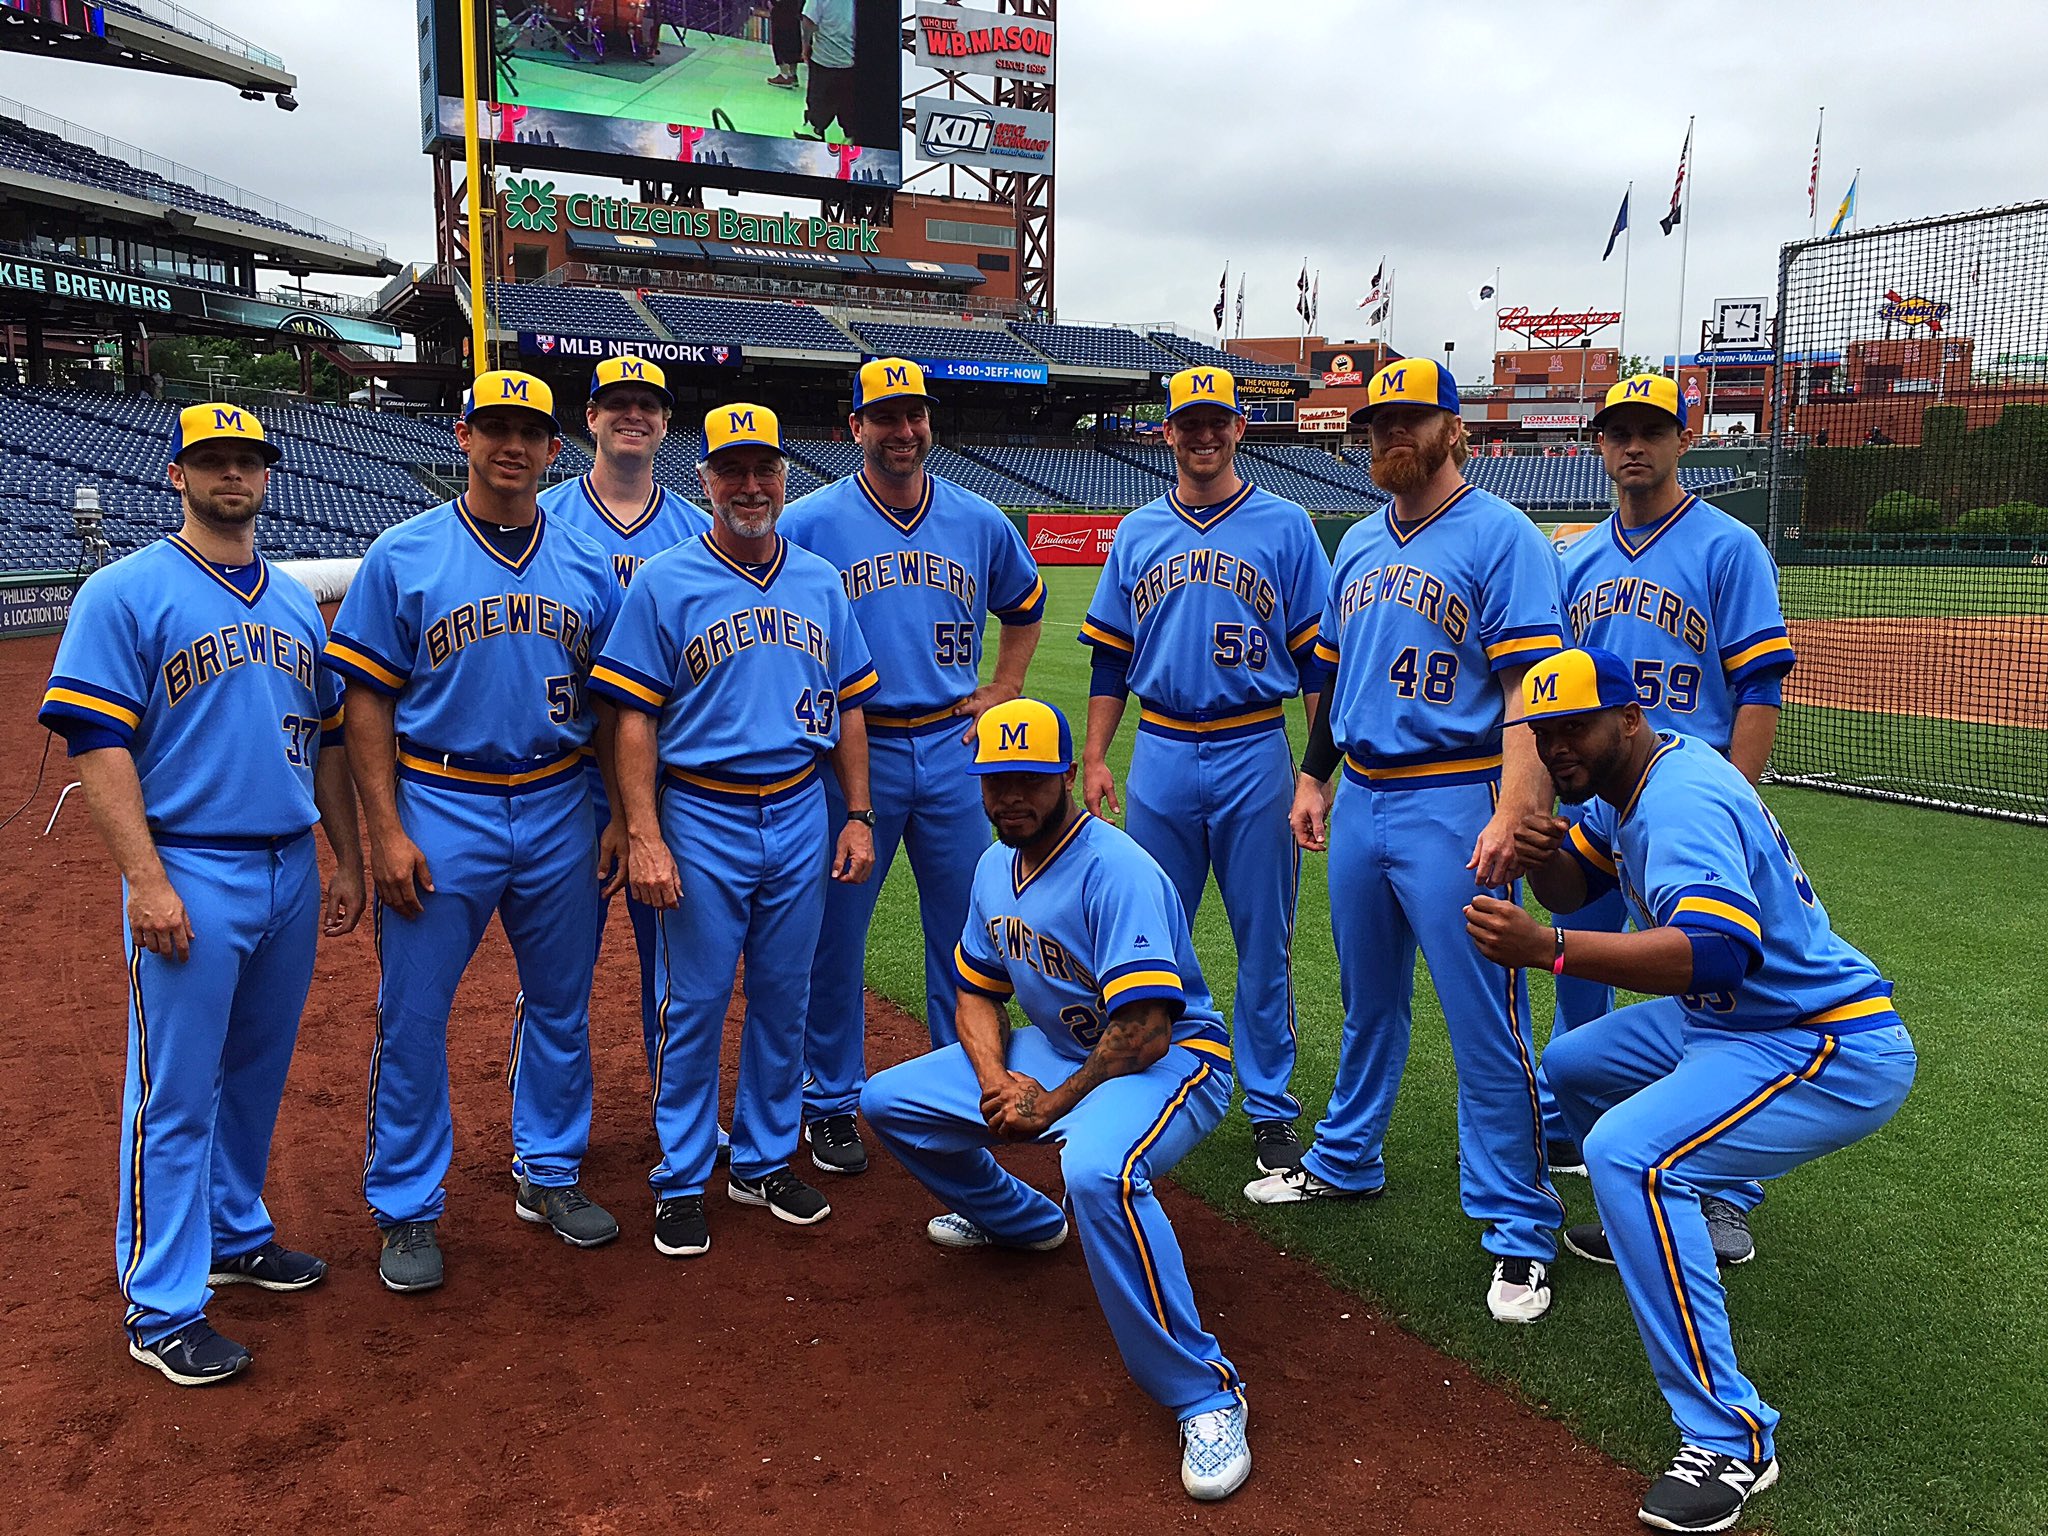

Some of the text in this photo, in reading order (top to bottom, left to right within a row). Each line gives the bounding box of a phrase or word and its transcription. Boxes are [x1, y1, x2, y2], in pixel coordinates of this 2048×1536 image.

[922, 18, 957, 30] WHO BUT
[996, 59, 1024, 70] SINCE
[566, 192, 880, 253] Citizens Bank Park
[732, 246, 789, 259] HARRY
[0, 260, 172, 312] KEE BREWERS
[1885, 304, 1946, 318] SUNOCO
[560, 338, 602, 356] MLB
[608, 340, 706, 362] NETWORK
[620, 361, 644, 379] M
[884, 366, 910, 387] M
[947, 364, 1042, 380] 1-800-JEFF-NOW
[501, 378, 530, 402] M
[1191, 374, 1215, 394] M
[1236, 386, 1295, 395] PHYSICAL THERAPY
[1280, 380, 1290, 388] OF
[1380, 369, 1407, 396] M
[1623, 380, 1653, 398] M
[212, 408, 246, 432] M
[728, 410, 756, 434] M
[1300, 422, 1345, 430] ALLEY STORE
[1036, 533, 1086, 544] Budweiser
[1096, 528, 1117, 540] THIS
[1132, 548, 1276, 624] BREWERS
[4, 612, 10, 626] &
[12, 606, 52, 626] LOCATION
[52, 606, 63, 620] TO
[1570, 577, 1708, 654] BREWERS
[424, 593, 590, 670] BREWERS
[934, 622, 975, 666] 55
[1213, 622, 1269, 672] 58
[1389, 646, 1460, 705] 48
[1634, 658, 1702, 714] 59
[1531, 672, 1559, 704] M
[794, 687, 836, 736] 43
[282, 713, 321, 768] 37
[998, 722, 1028, 750] M
